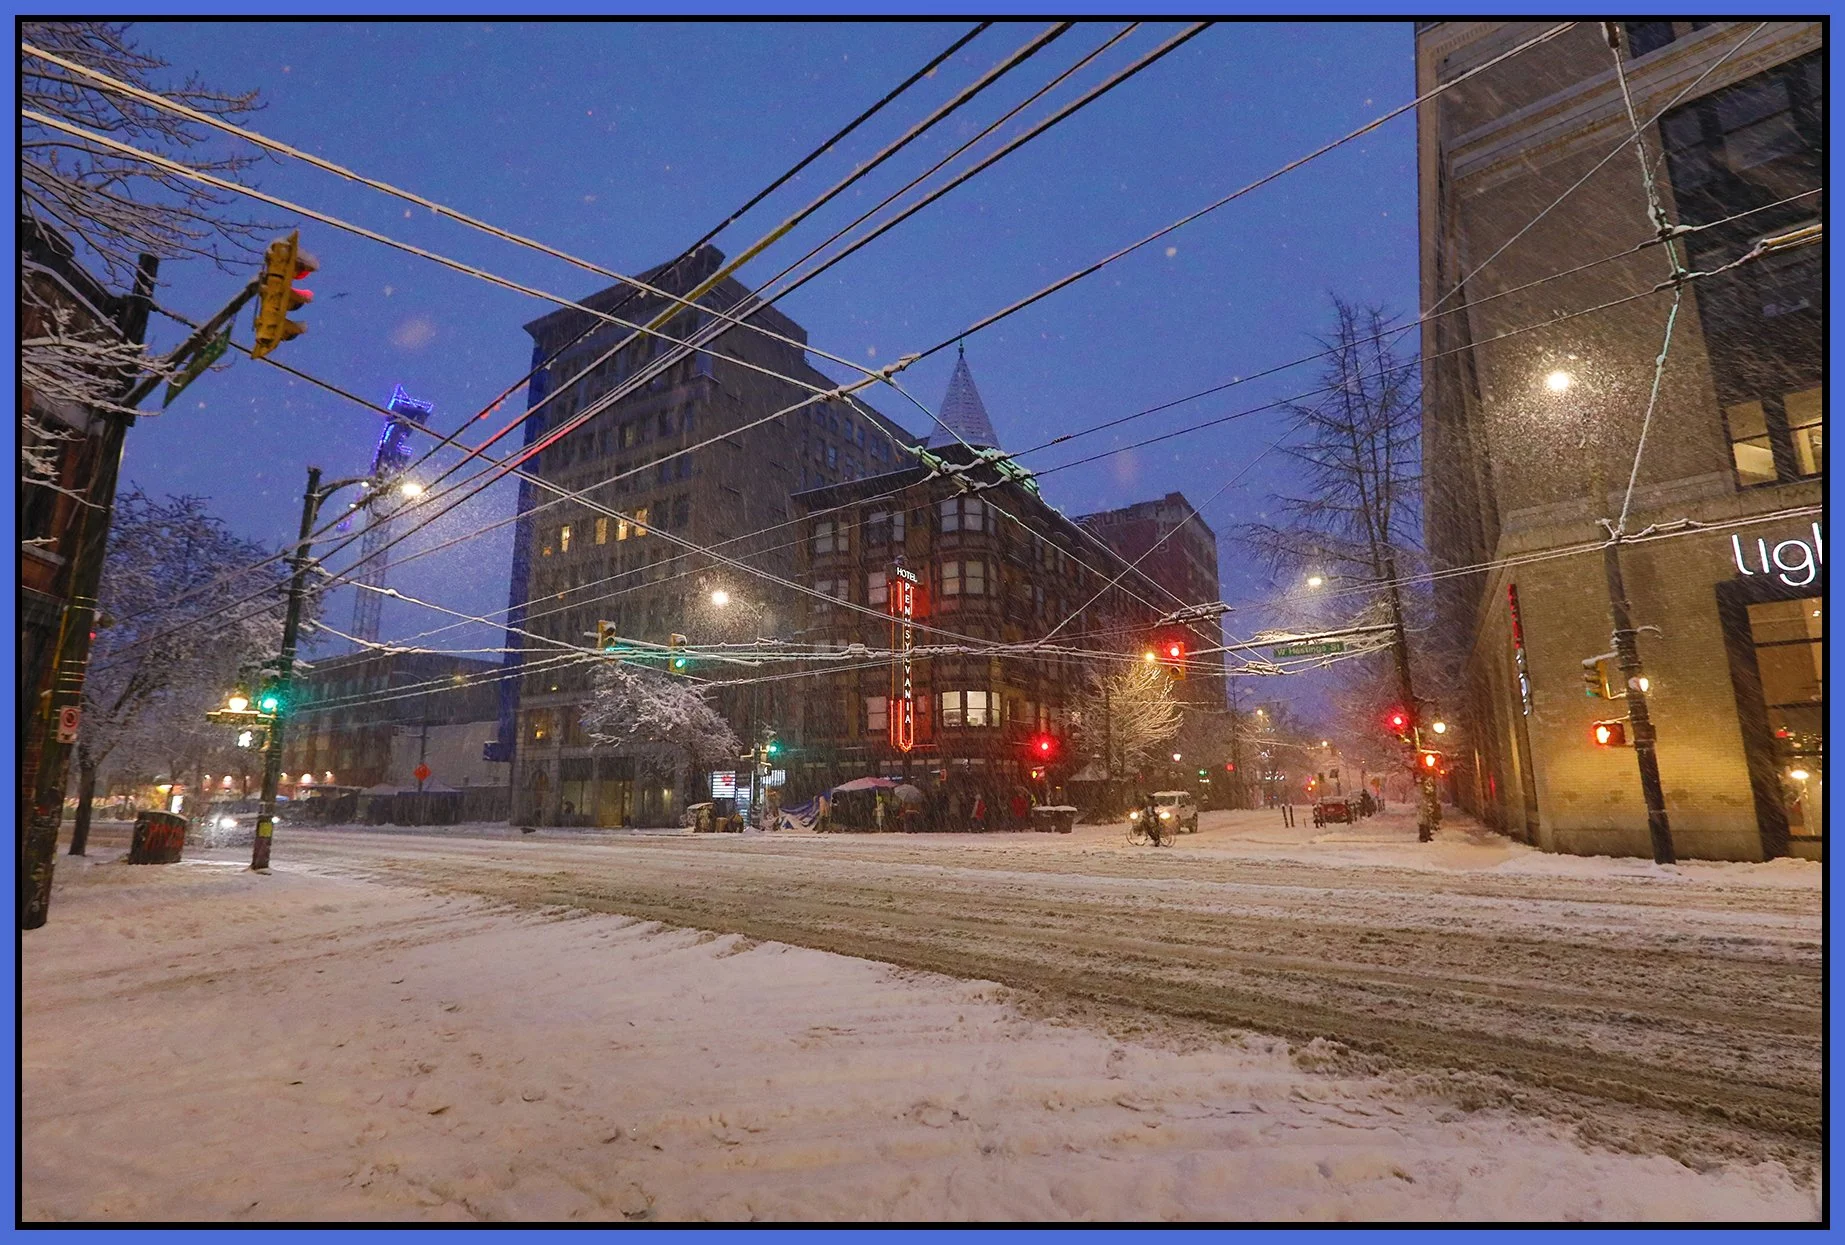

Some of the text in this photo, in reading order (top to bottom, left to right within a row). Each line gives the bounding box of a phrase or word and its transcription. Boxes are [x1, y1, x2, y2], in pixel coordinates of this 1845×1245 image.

[896, 567, 917, 583] HOTEL
[1277, 643, 1341, 656] W Hastings St
